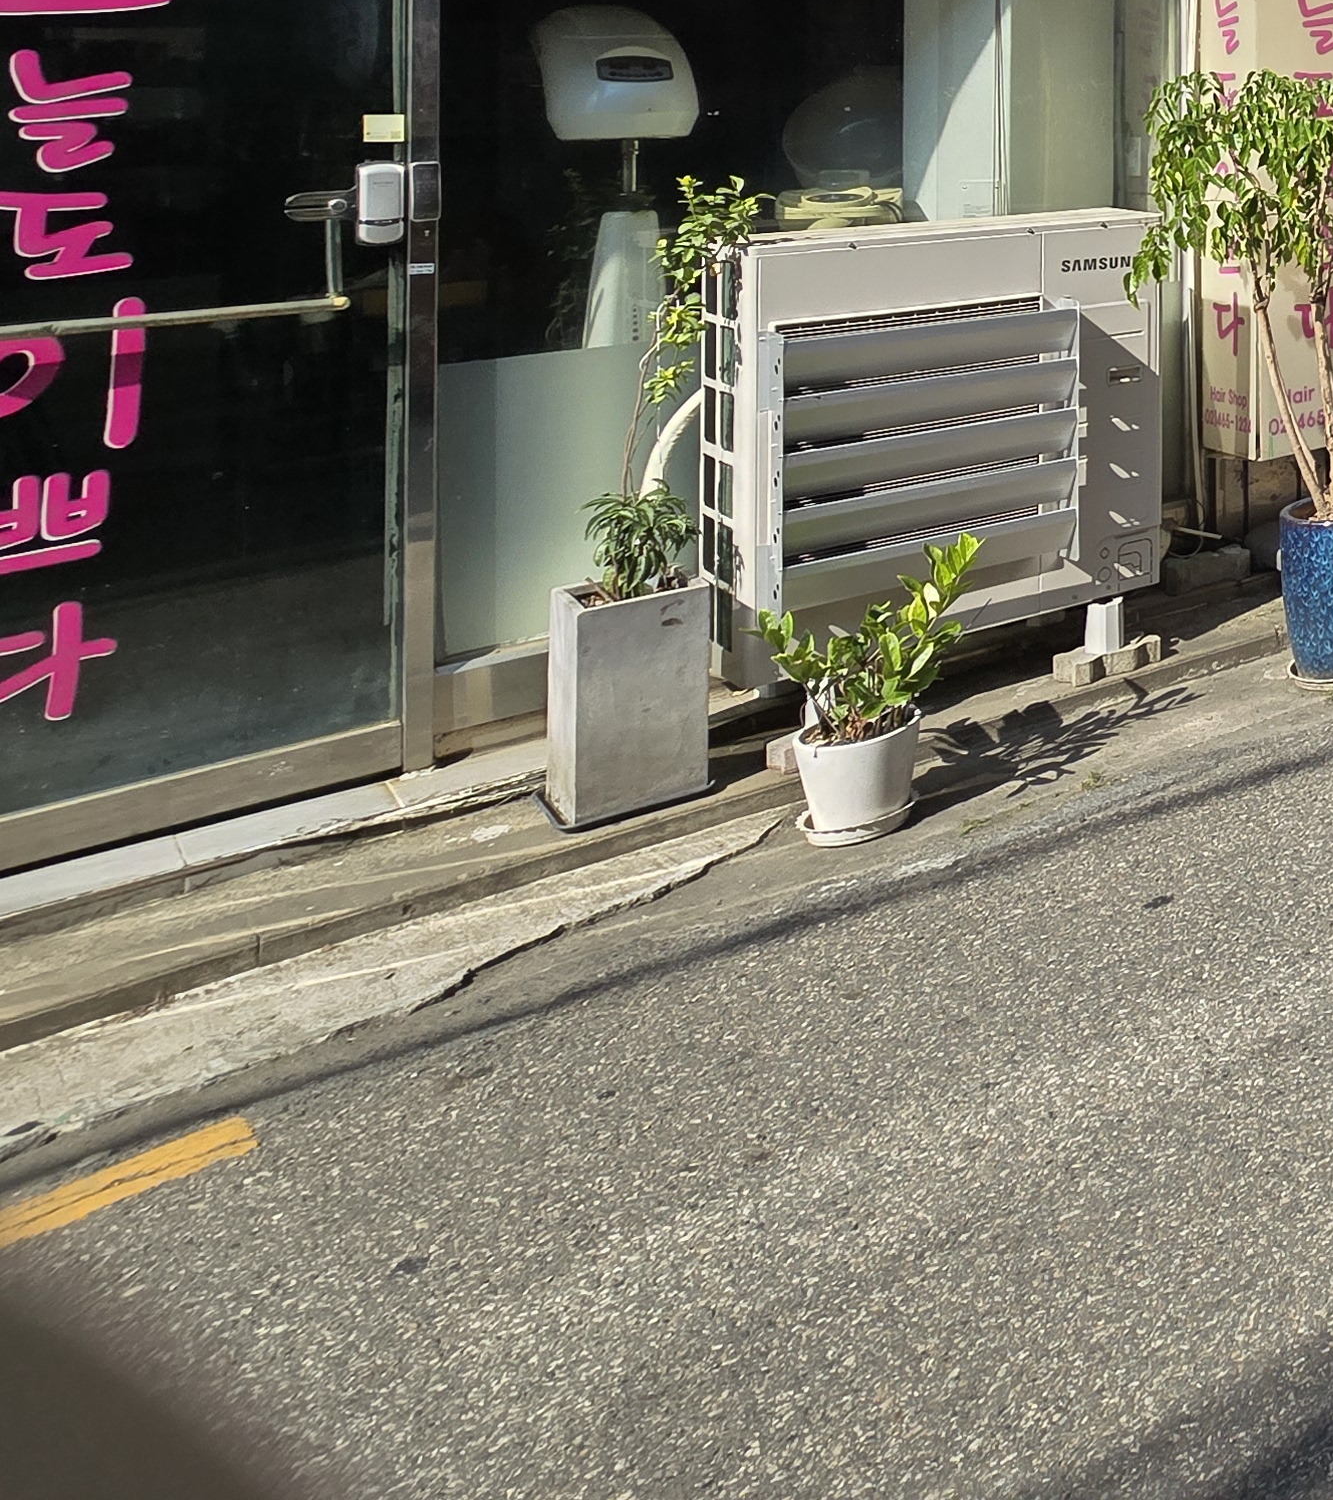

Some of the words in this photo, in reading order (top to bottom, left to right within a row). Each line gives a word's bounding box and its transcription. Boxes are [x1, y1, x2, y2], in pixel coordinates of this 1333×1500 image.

[1061, 255, 1131, 273] SAMSUN
[1210, 384, 1226, 403] Hair
[1228, 388, 1248, 408] Shop
